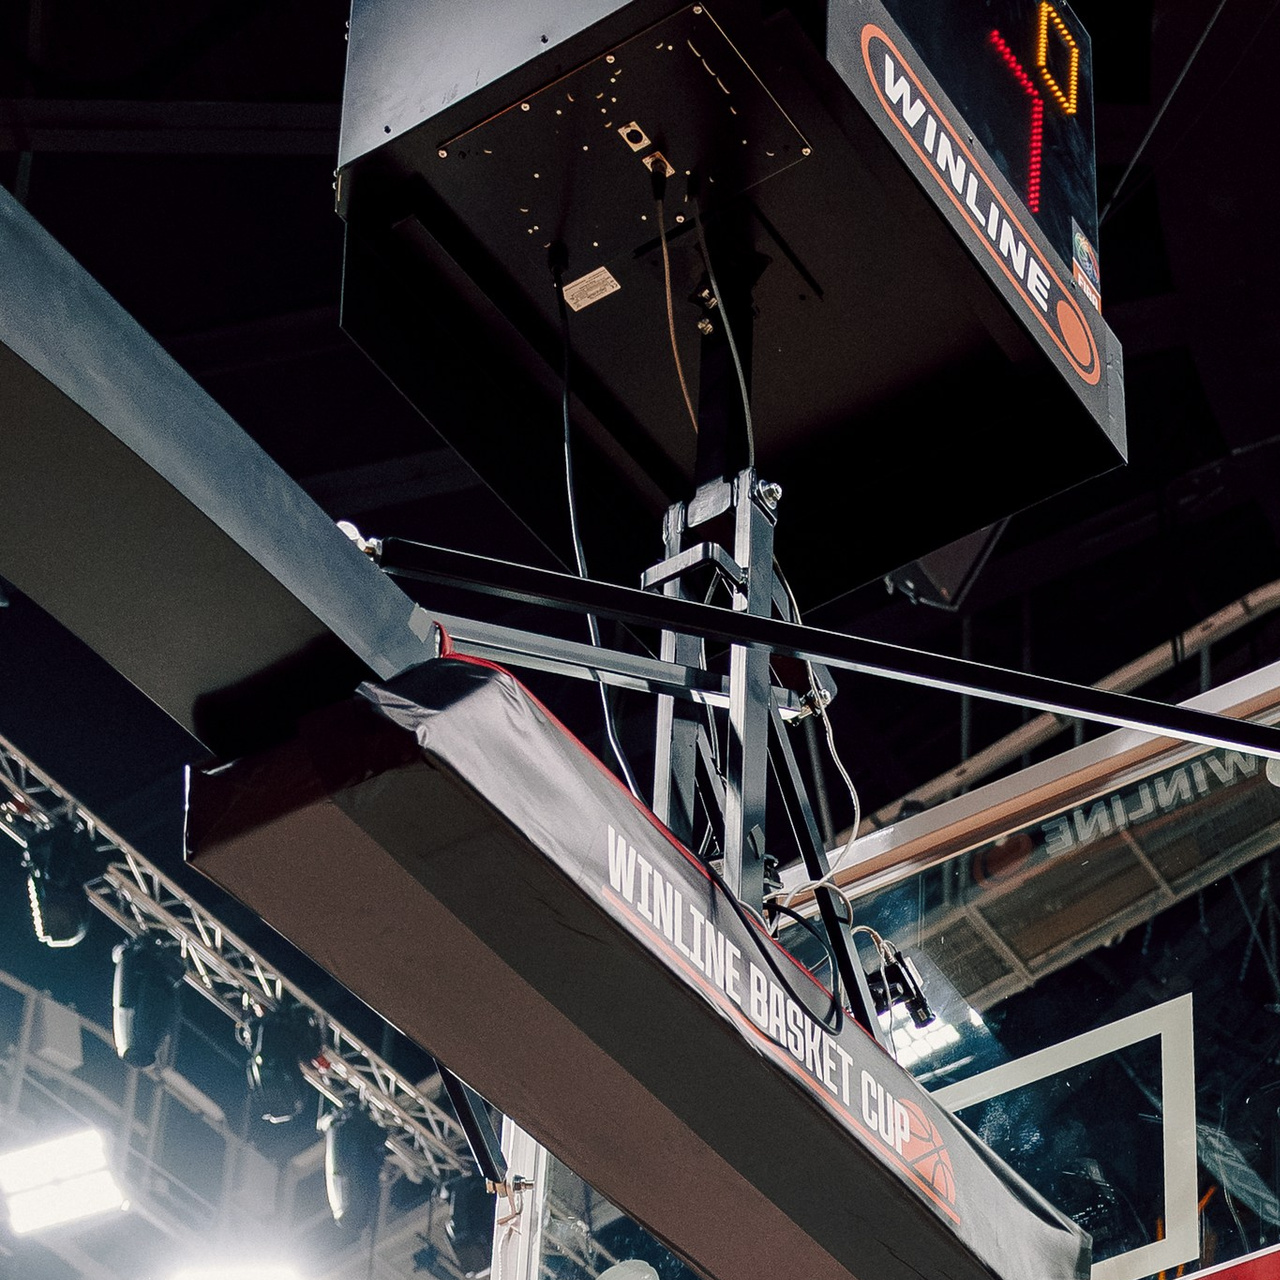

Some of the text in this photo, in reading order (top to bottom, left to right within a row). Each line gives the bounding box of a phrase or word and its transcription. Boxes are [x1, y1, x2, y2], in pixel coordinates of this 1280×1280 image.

[884, 53, 1051, 312] WINLINE
[607, 825, 911, 1157] WINLINE BASKET CUP
